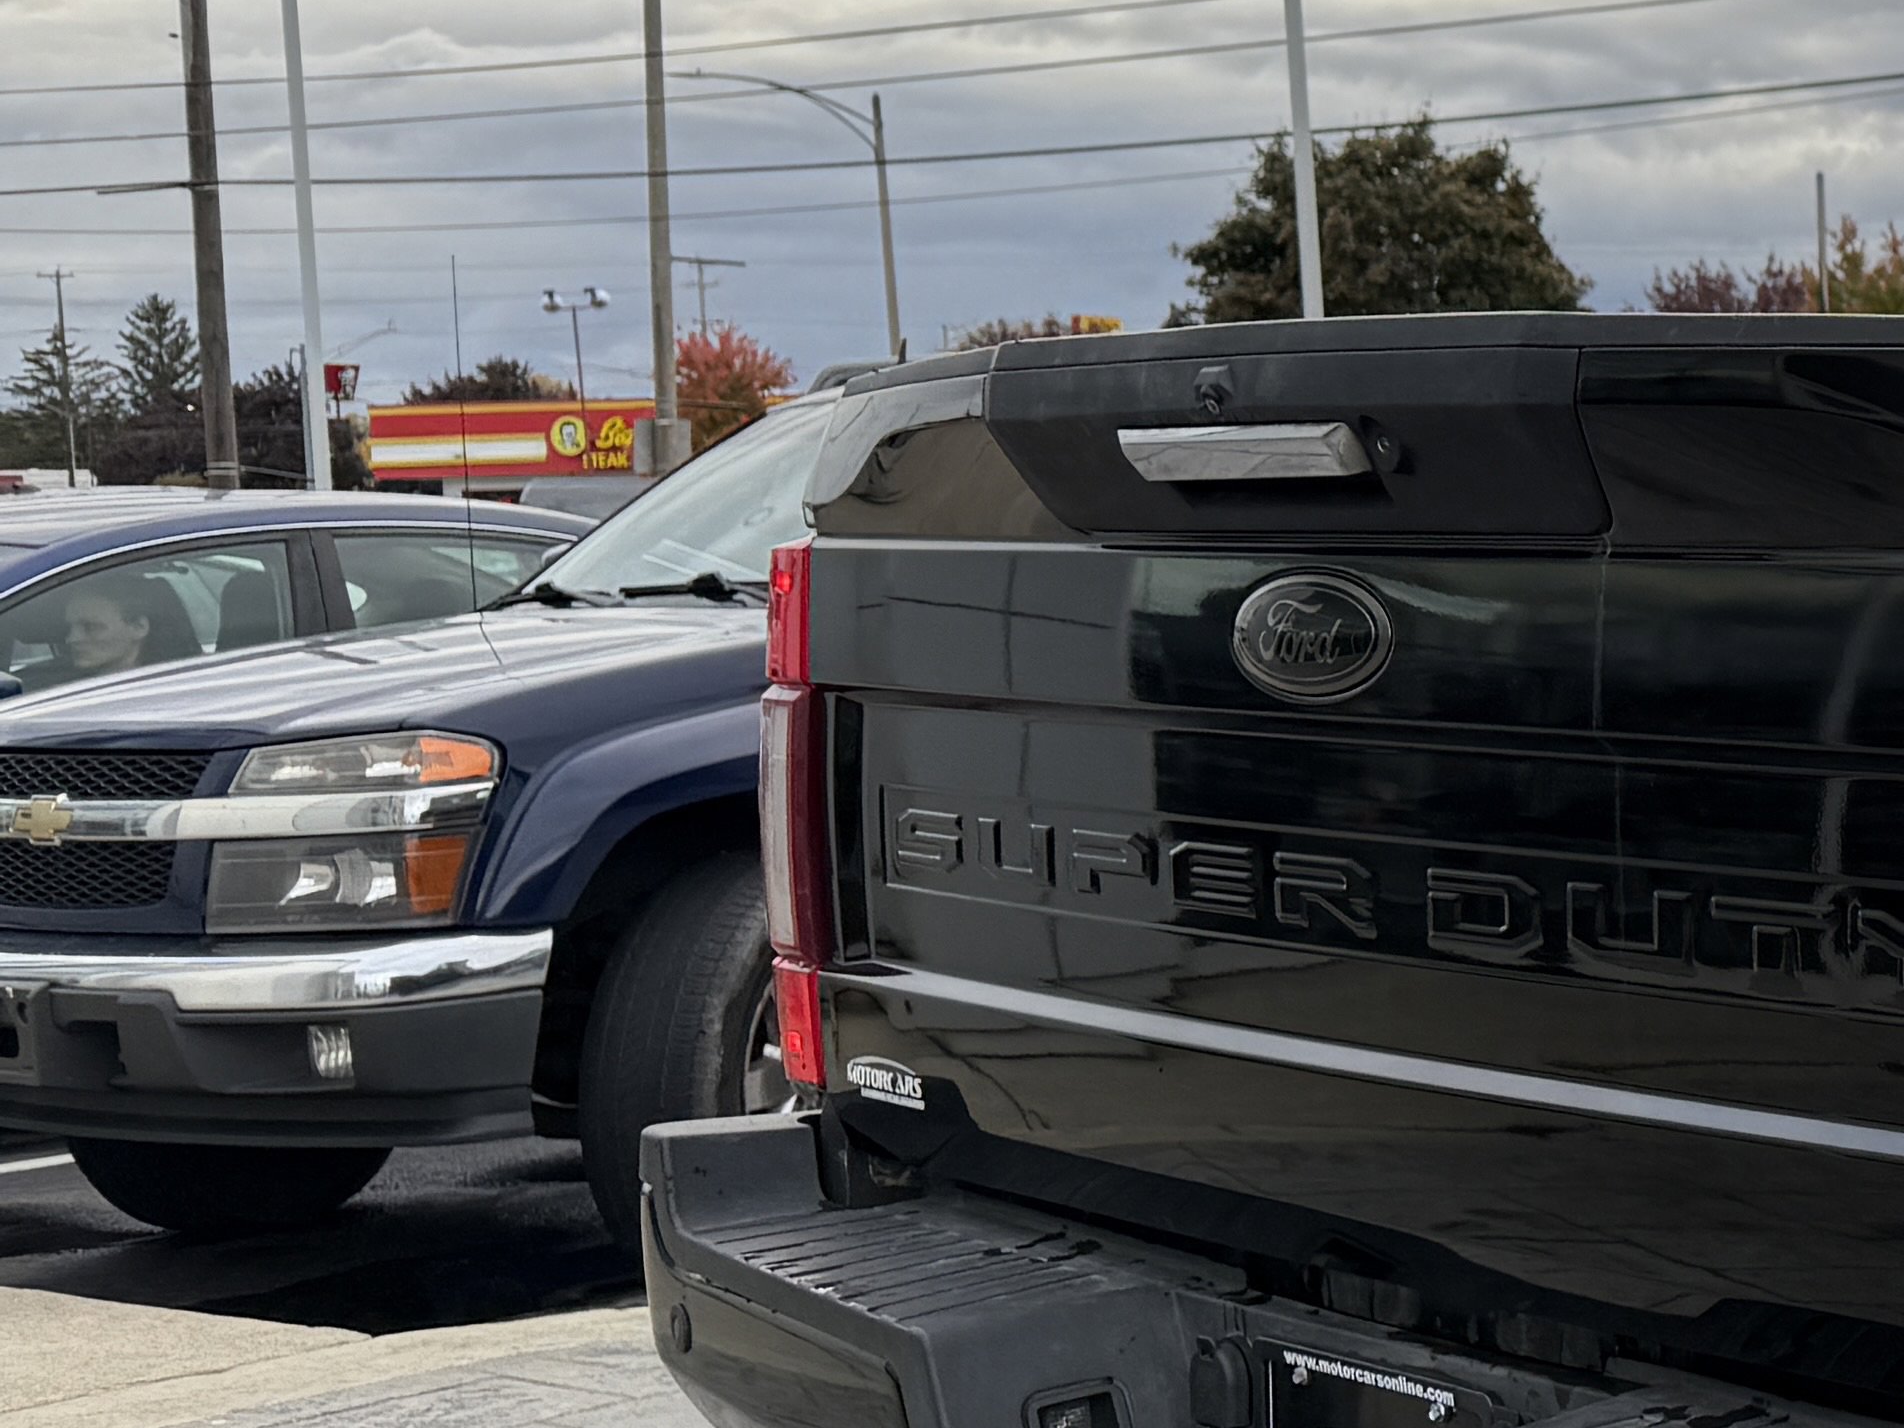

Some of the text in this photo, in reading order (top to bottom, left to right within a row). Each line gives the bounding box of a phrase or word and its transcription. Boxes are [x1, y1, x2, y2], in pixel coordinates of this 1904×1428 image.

[1259, 599, 1343, 665] Ford
[892, 805, 1380, 940] SUPER
[846, 1063, 923, 1099] MOTORCARS
[1283, 1349, 1456, 1408] www.motorcarsonline.com
